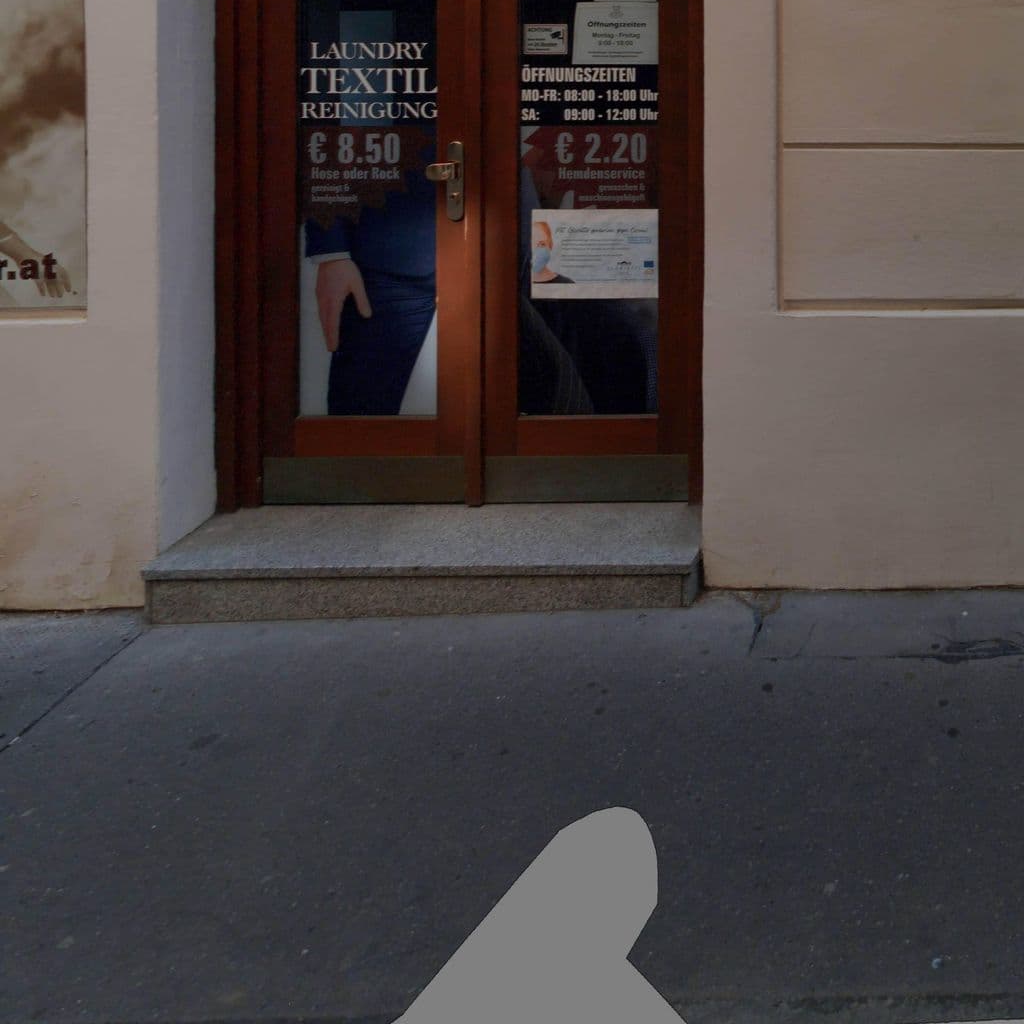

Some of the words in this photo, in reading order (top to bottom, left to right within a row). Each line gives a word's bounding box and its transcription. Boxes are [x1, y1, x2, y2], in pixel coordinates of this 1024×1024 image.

[587, 20, 647, 29] Öffnungszeiten
[310, 42, 428, 60] LAUNDRY
[300, 67, 439, 94] TEXTIL
[521, 64, 637, 83] ÖFFNUNGSZEITEN
[521, 89, 562, 102] MO-FR:
[563, 89, 596, 102] 08:00
[605, 89, 637, 102] 18:00
[639, 89, 659, 102] Uhr
[301, 101, 439, 119] REINIGUNG
[521, 108, 541, 121] SA:
[563, 108, 596, 121] 09:00
[605, 108, 637, 121] 12:00
[639, 108, 659, 121] Uhr
[306, 132, 328, 164] €
[338, 133, 401, 164] 8.50
[554, 132, 574, 164] €
[584, 133, 647, 164] 2.20
[311, 167, 340, 180] Hose
[343, 167, 369, 180] oder
[371, 167, 401, 180] Rock
[558, 167, 646, 180] Hemdenservice
